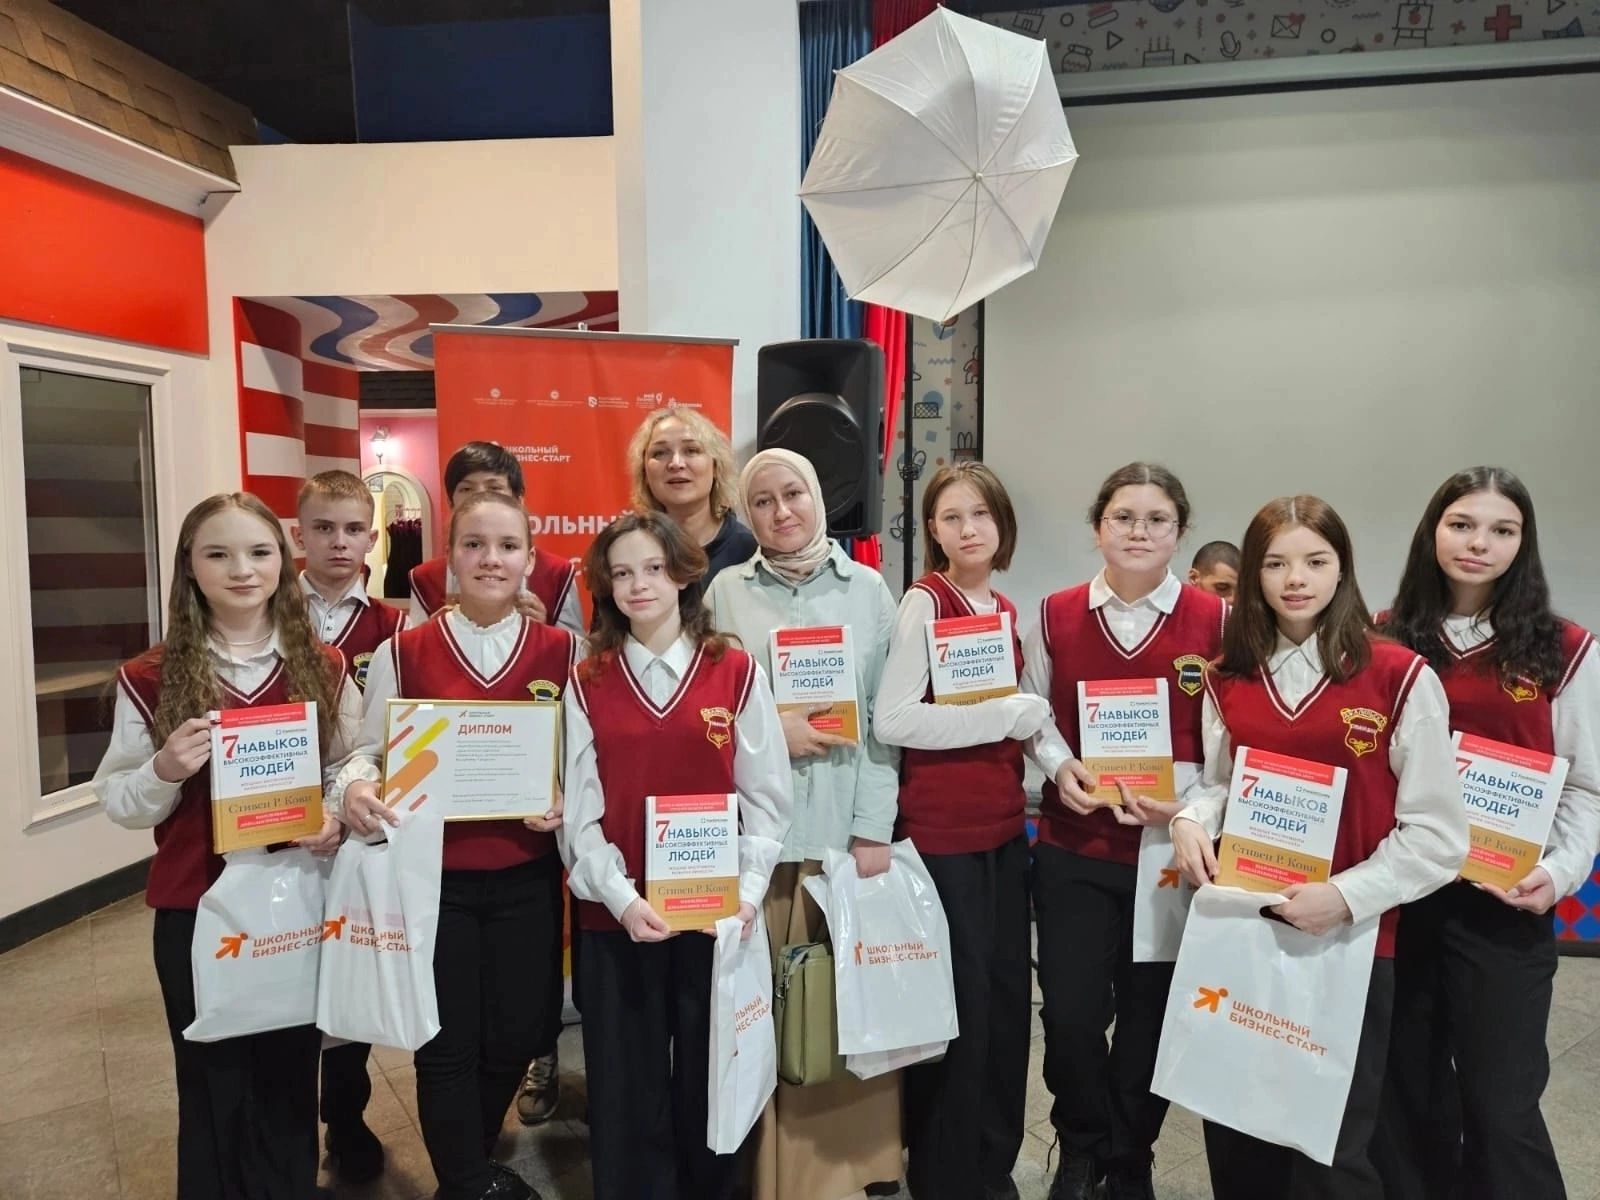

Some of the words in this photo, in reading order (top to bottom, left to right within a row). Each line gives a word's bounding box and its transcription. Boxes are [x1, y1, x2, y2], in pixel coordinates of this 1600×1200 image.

[778, 652, 790, 671] 7
[789, 657, 844, 669] НАВЫКОВ
[936, 643, 948, 662] 7
[948, 644, 1004, 658] НАВЫКОВ
[952, 663, 994, 679] ЛЮДЕЙ
[792, 676, 833, 688] ЛЮДЕЙ
[1086, 703, 1099, 722] 7
[1098, 709, 1159, 720] НАВЫКОВ
[458, 724, 512, 735] ДИПЛОМ
[1101, 729, 1147, 741] ЛЮДЕЙ
[222, 734, 239, 758] 7
[237, 736, 308, 754] НАВЫКОВ
[240, 758, 294, 777] ЛЮДЕЙ
[1455, 757, 1473, 776] 7
[1466, 770, 1543, 799] НАВЫКОВ
[1241, 774, 1259, 798] 7
[1254, 786, 1328, 813] НАВЫКОВ
[1463, 783, 1539, 809] ОКОЭФФЕКТИВНЫХ
[656, 820, 670, 842] 7
[667, 827, 728, 839] НАВЫКОВ
[1250, 811, 1307, 834] ЛЮДЕЙ
[668, 848, 715, 862] ЛЮДЕЙ
[1232, 843, 1272, 861] Стивен
[351, 923, 404, 941] ШКОНЫЙ
[735, 993, 762, 1022] ЛЬНЫЙ
[1232, 1000, 1311, 1038] ШКОЛЬНЫЙ
[1229, 1012, 1328, 1056] БИЗНЕС-СТАРТ
